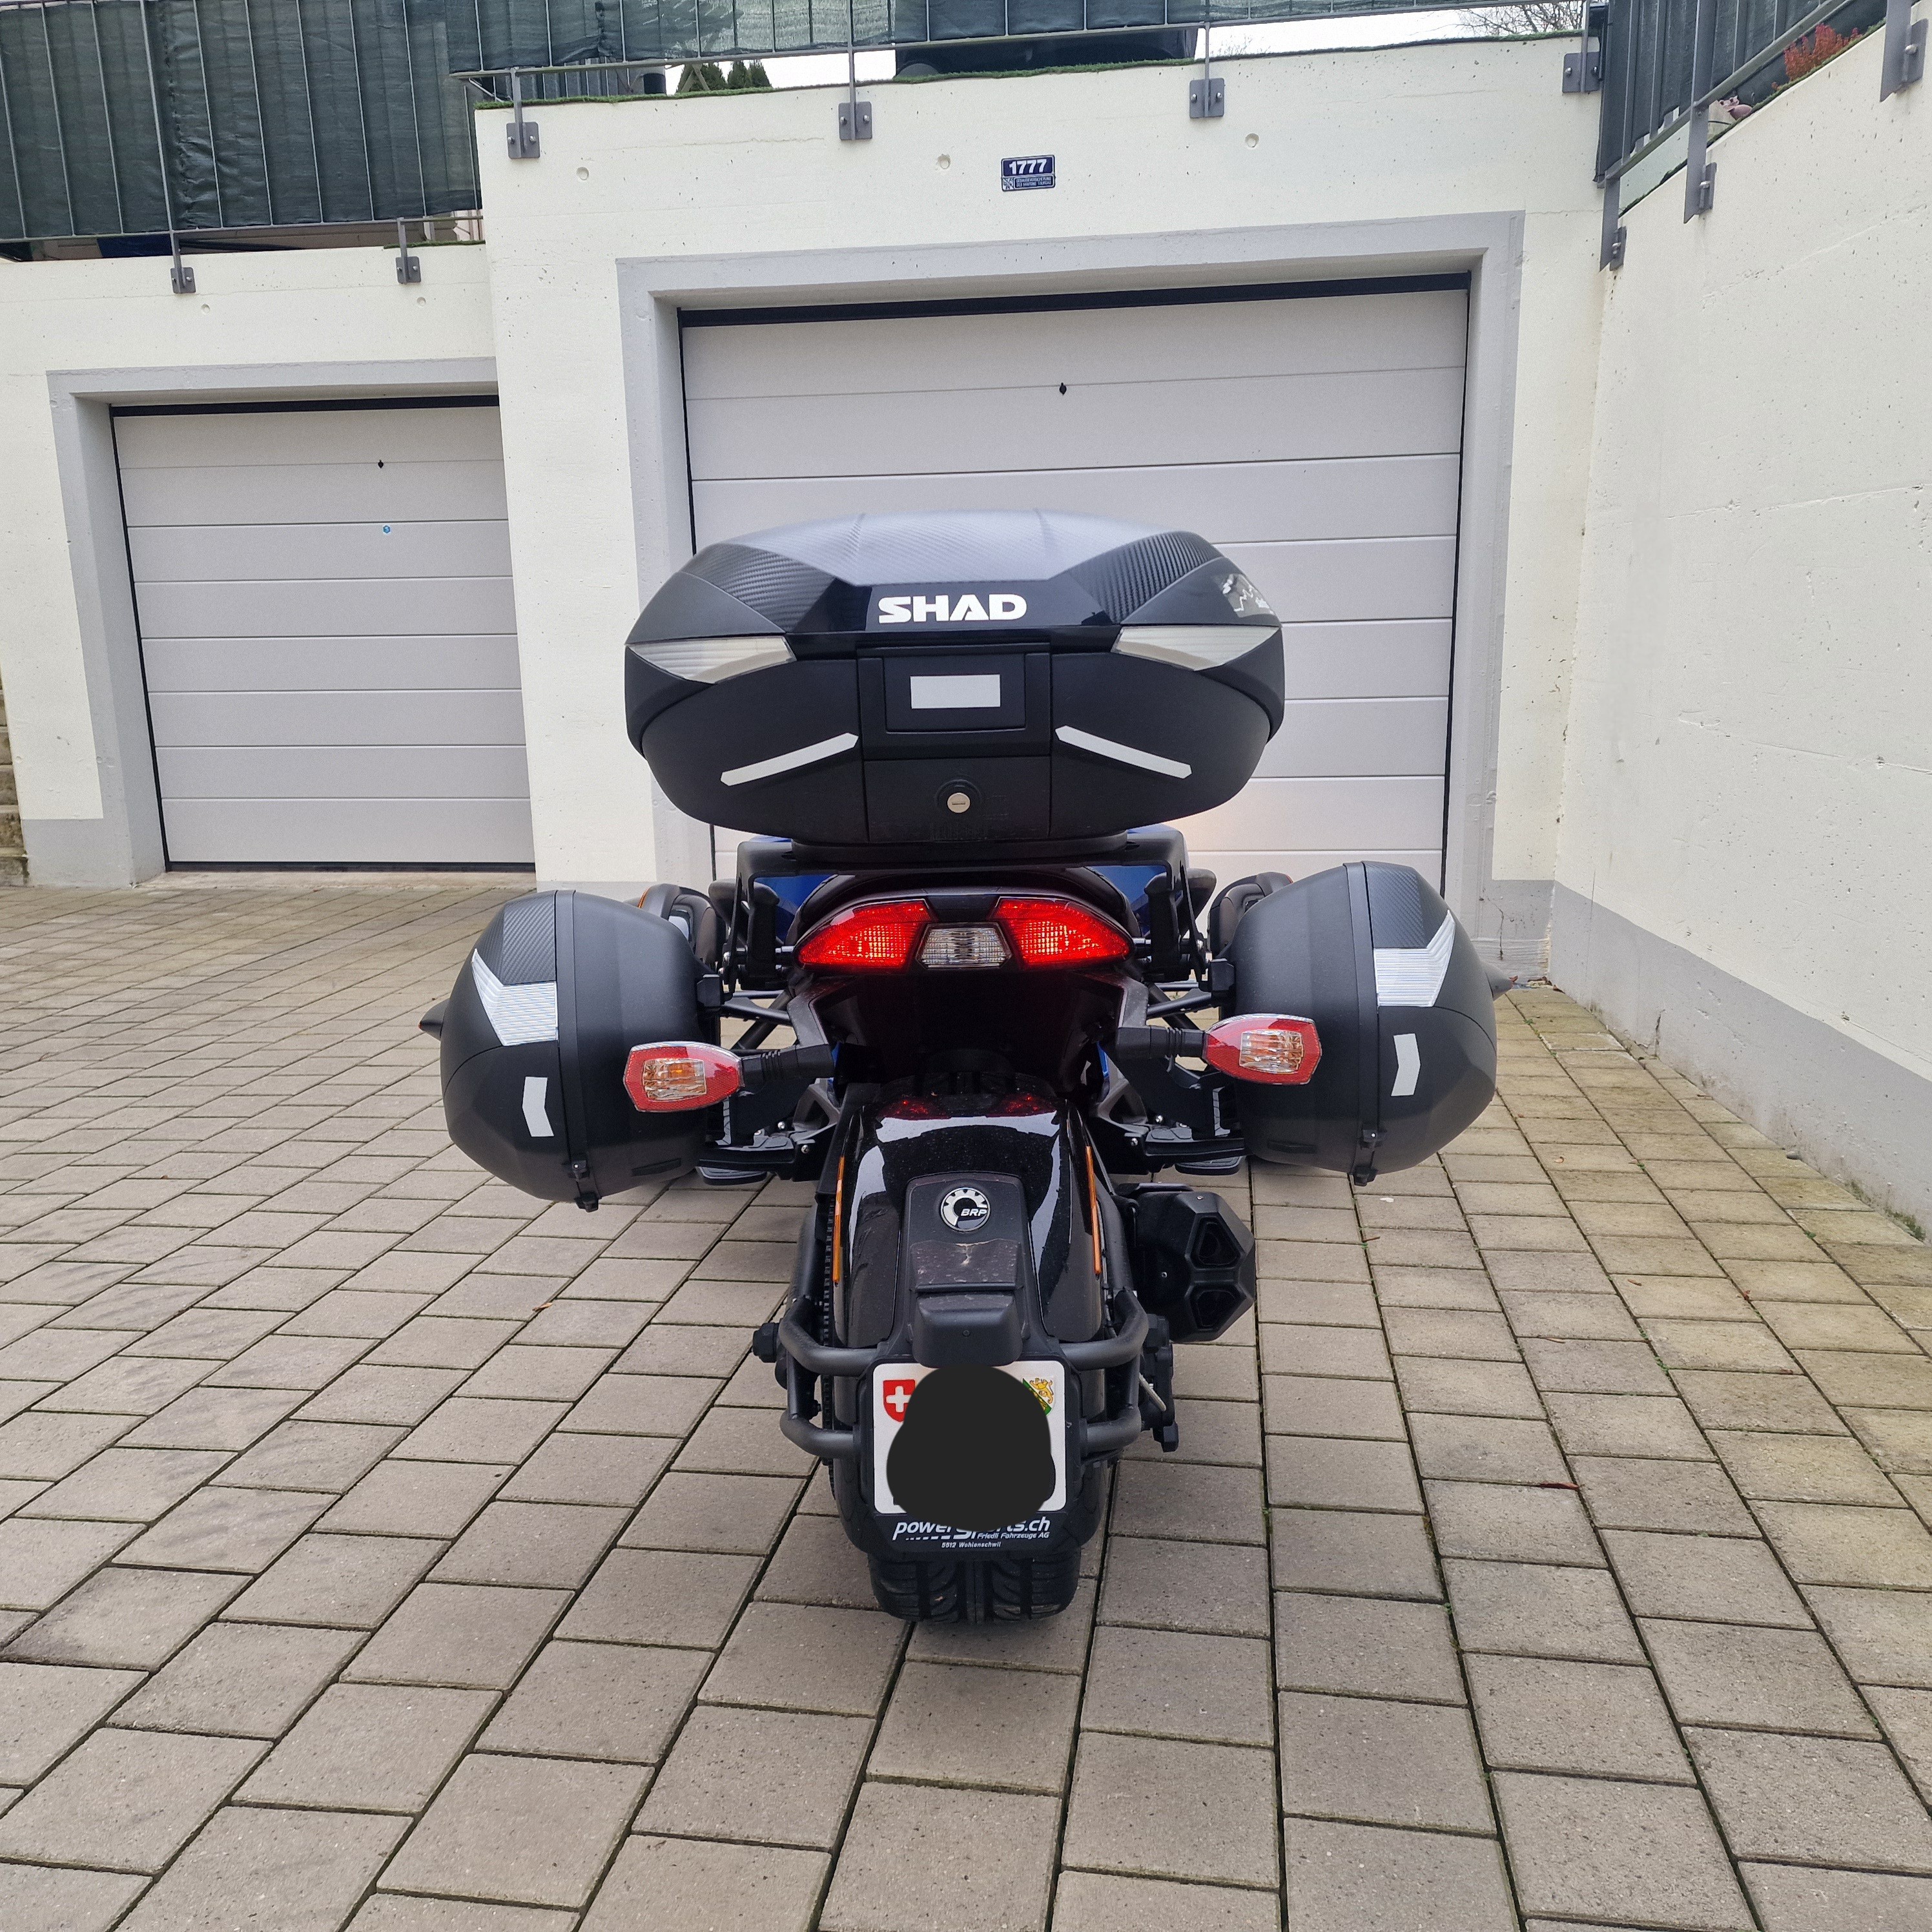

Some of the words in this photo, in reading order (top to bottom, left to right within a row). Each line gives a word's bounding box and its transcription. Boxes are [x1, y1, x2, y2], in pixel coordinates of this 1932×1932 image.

[1009, 159, 1047, 174] 1777
[878, 594, 1027, 624] SHAD
[960, 1208, 987, 1217] BRP
[892, 1516, 1051, 1541] powes.ch
